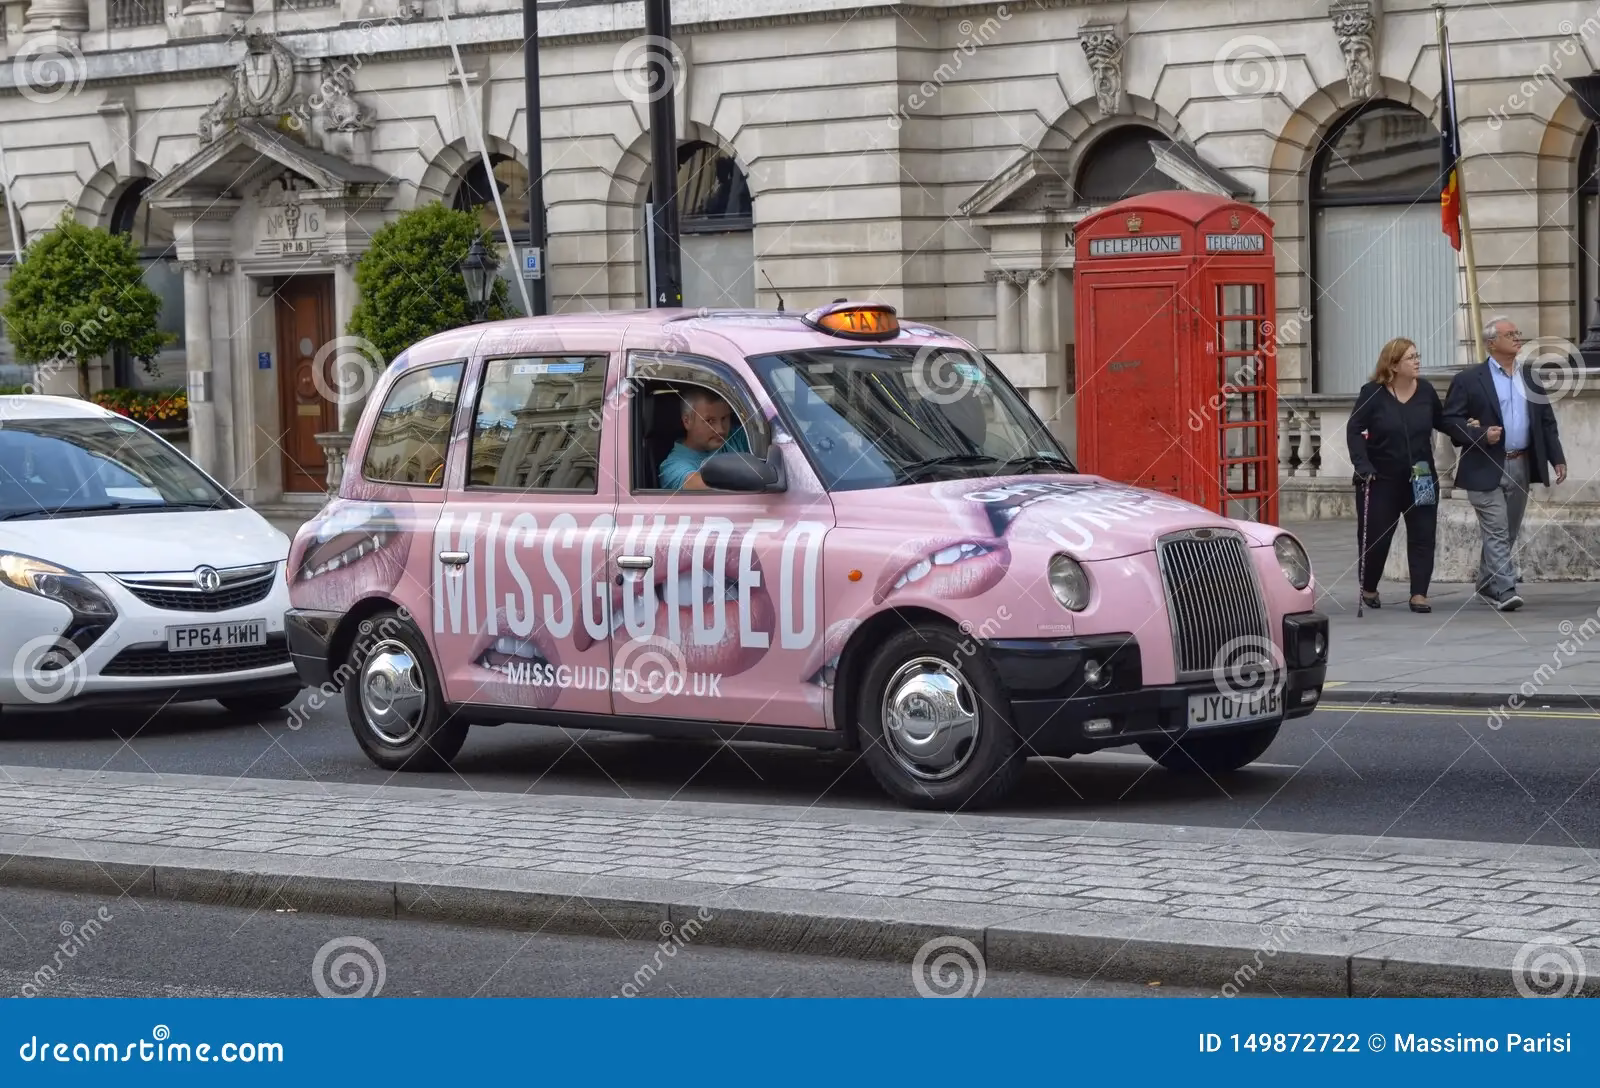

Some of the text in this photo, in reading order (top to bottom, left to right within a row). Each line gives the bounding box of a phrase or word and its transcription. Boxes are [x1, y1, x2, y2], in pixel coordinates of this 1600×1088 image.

[304, 212, 319, 233] 16
[295, 242, 304, 252] 16
[1094, 236, 1179, 254] TELEPHONE
[1207, 235, 1261, 250] TELEPHONE
[660, 292, 667, 303] 4
[434, 511, 828, 650] MISSGUIDED
[176, 624, 259, 647] FP64 HWH
[506, 661, 722, 698] MISSGUIDED.CO.UK
